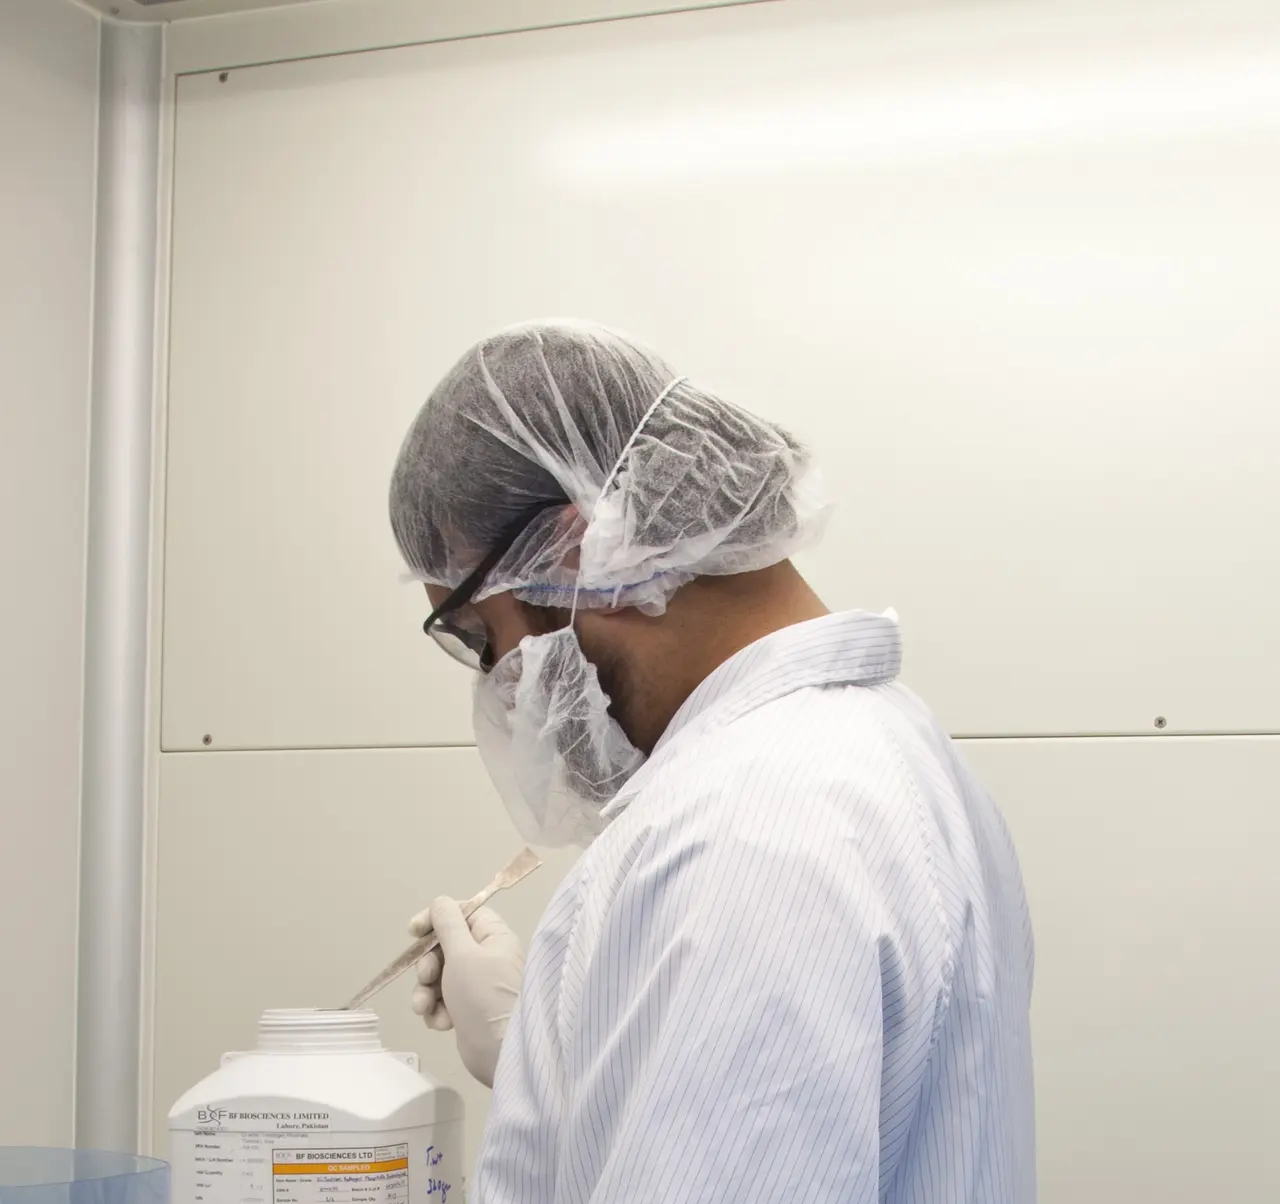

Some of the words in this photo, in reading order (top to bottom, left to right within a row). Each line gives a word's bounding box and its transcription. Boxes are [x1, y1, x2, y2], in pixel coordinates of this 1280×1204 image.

[229, 1112, 238, 1120] BF
[240, 1112, 291, 1120] BIOSCIENCES
[293, 1112, 329, 1120] LIMITED
[307, 1152, 357, 1160] BIOSCIENCES
